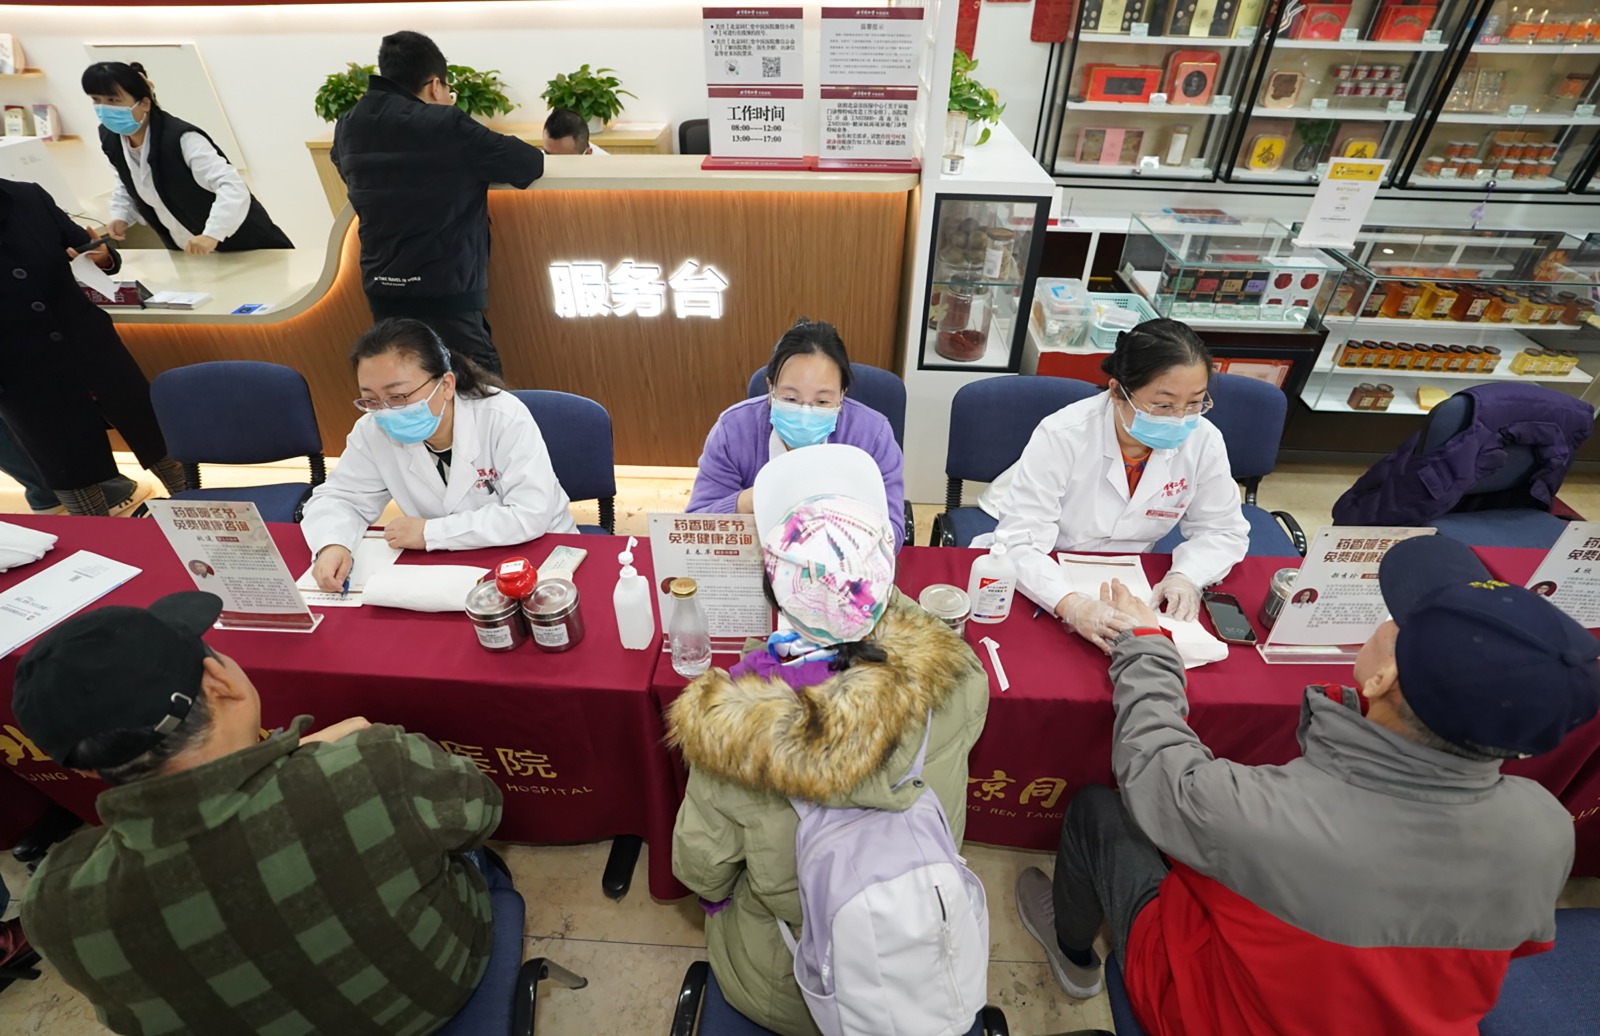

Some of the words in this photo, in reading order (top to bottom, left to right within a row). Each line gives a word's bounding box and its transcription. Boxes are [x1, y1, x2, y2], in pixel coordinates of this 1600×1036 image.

[727, 105, 785, 122] 工作时间
[549, 259, 728, 319] 服务台
[171, 506, 237, 519] 药香暖冬节
[173, 519, 250, 532] 免费健康咨询
[674, 519, 745, 532] 药香暖冬节
[669, 532, 753, 545] 免费健康咨询
[505, 783, 594, 797] HOSPITAL
[990, 807, 1018, 818] REN
